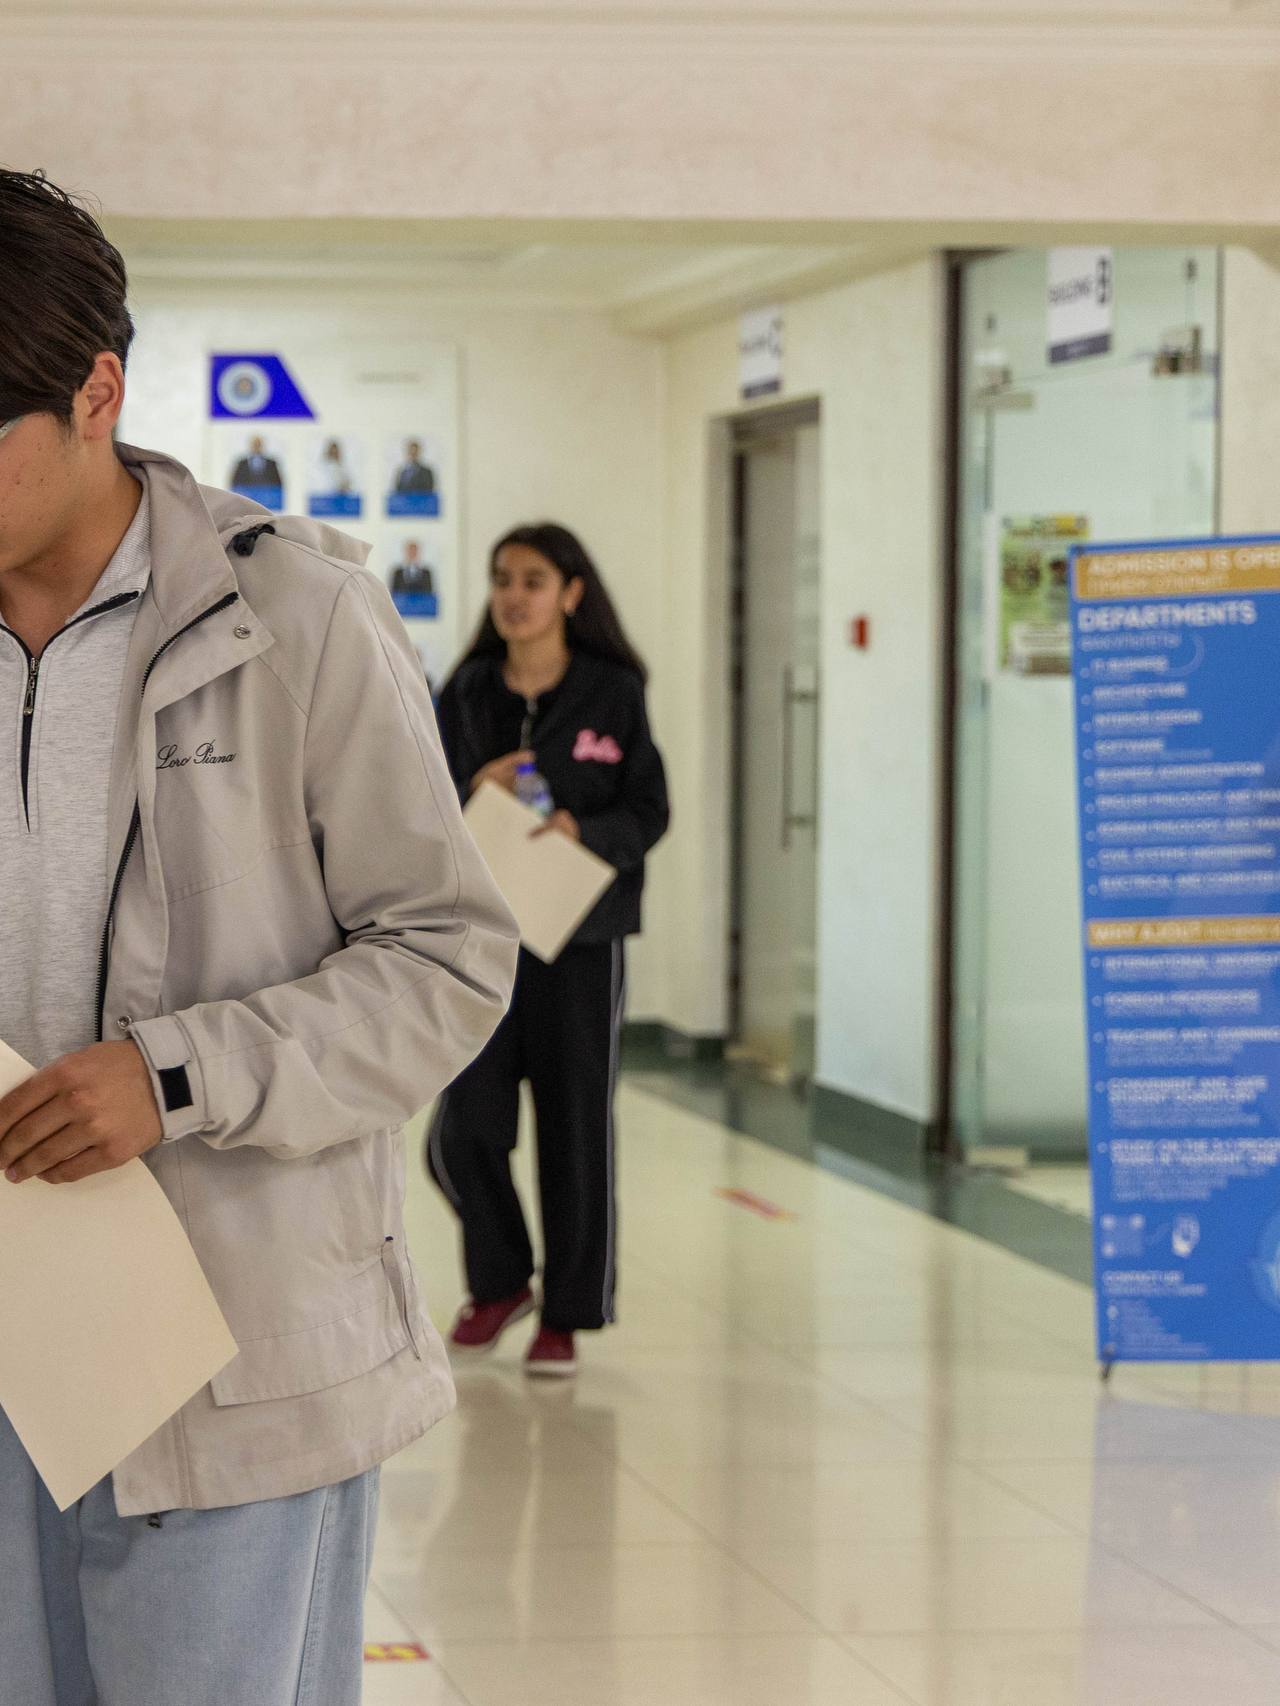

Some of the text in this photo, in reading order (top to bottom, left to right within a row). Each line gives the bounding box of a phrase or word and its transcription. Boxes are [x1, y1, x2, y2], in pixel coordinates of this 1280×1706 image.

[1090, 554, 1206, 575] ADMISSION
[1211, 550, 1230, 570] IS
[1078, 601, 1257, 631] DEPARTMENTS
[156, 739, 237, 769] Loro Piana
